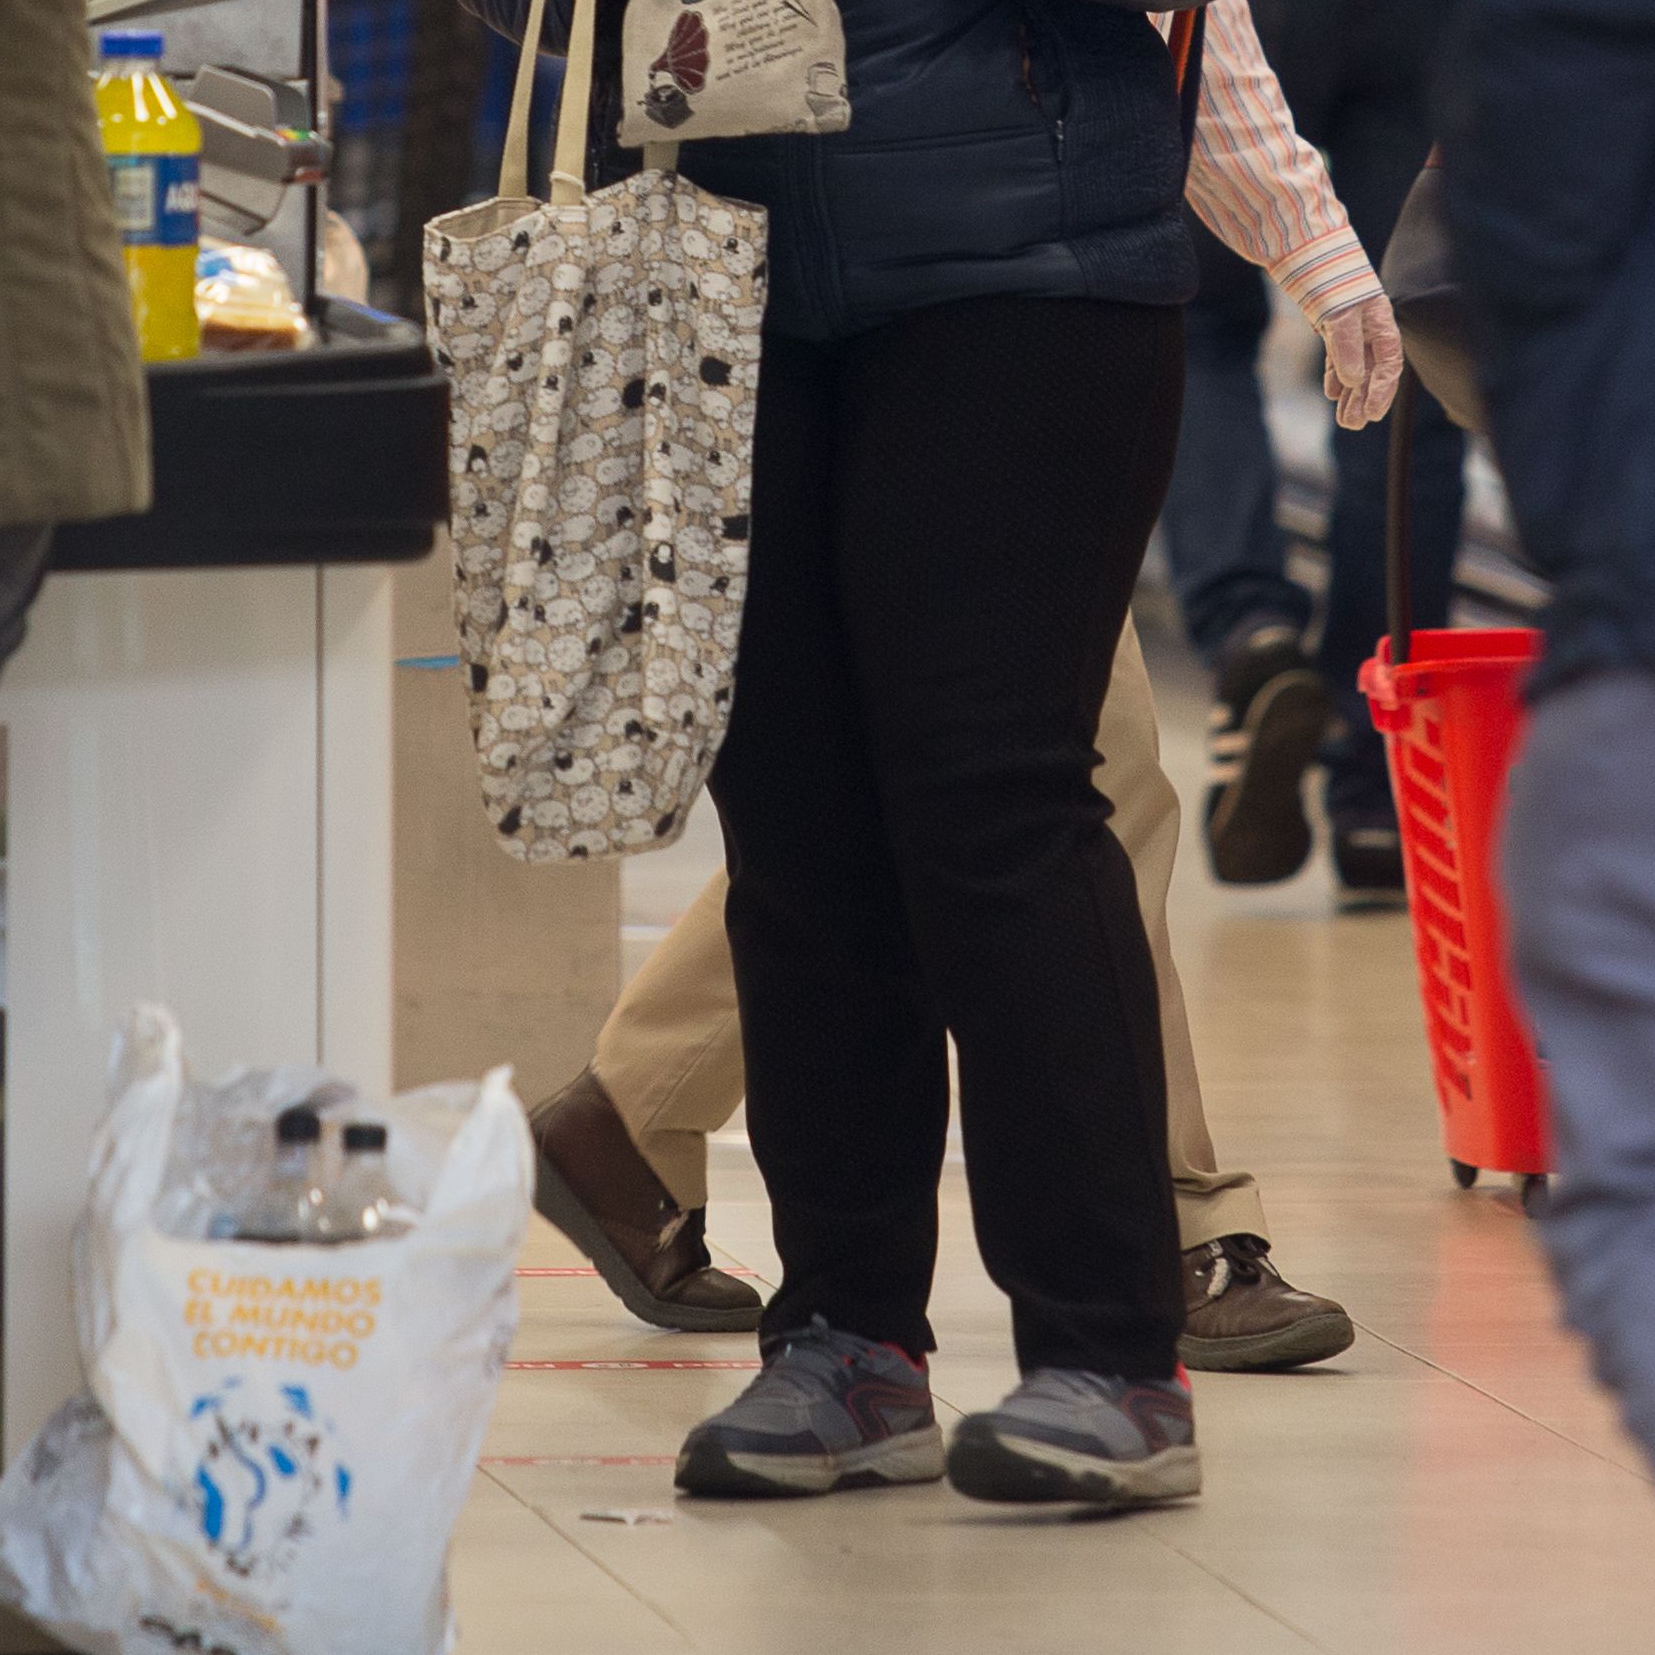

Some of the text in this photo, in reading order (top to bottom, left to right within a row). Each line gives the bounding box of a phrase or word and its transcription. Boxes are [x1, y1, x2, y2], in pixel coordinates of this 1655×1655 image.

[186, 1267, 382, 1307] CUIDAMOS
[184, 1298, 376, 1340] EL MUNDO
[192, 1329, 360, 1371] CONTIGO
